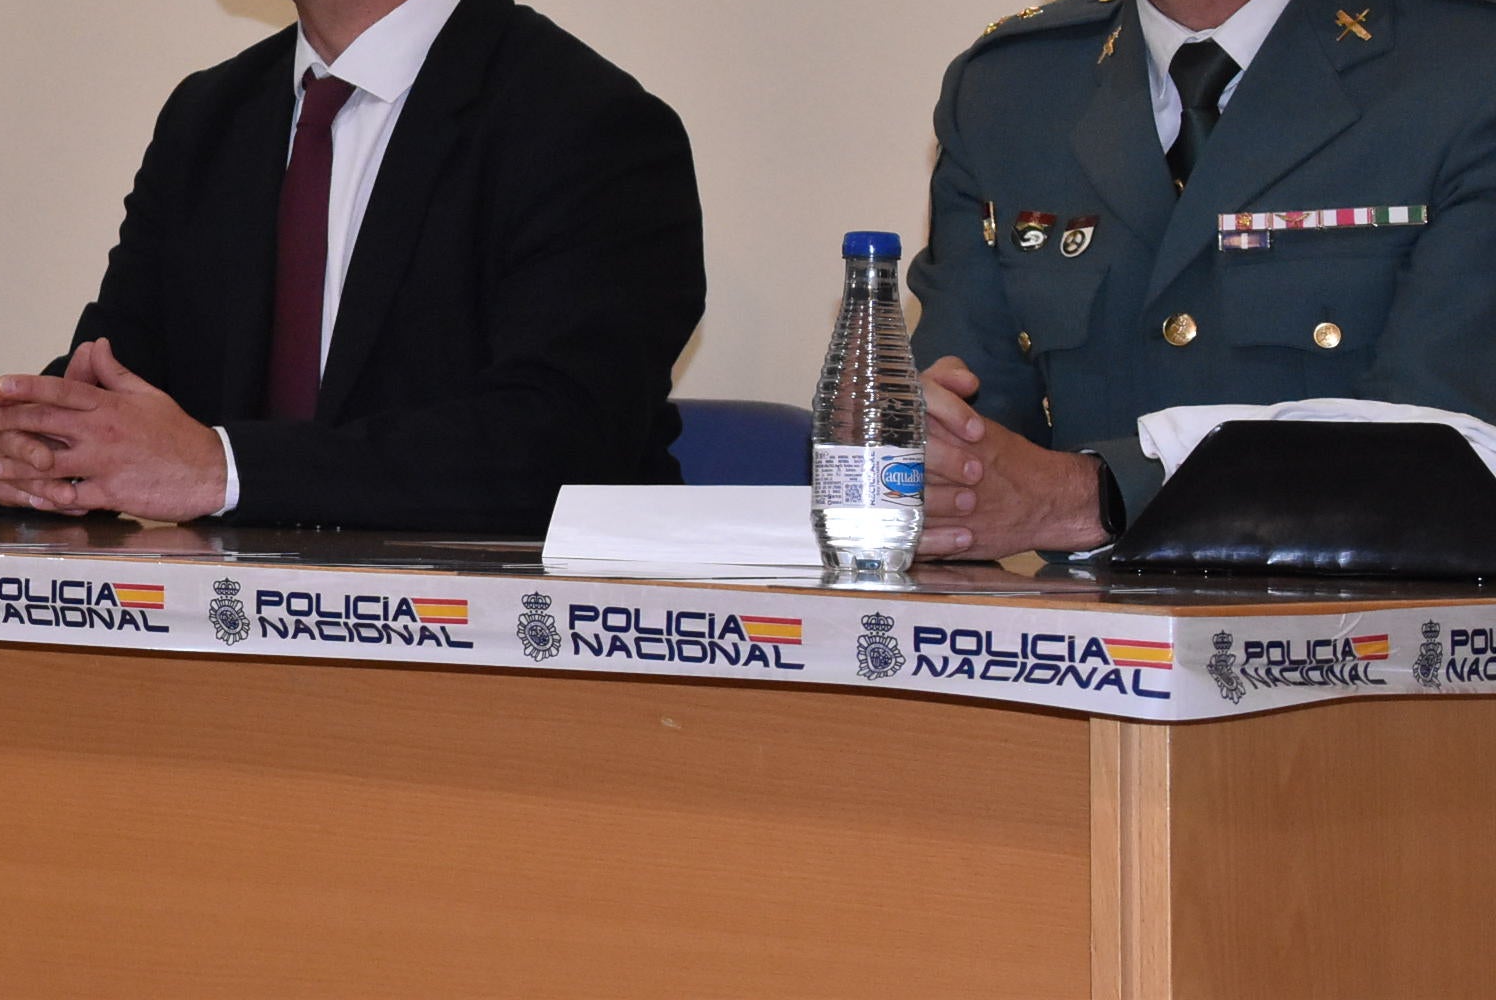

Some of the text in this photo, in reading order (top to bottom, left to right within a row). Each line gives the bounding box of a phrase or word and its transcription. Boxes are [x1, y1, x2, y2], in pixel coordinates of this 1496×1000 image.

[258, 616, 474, 649] NACIONAL
[571, 632, 805, 670] NACIONAL
[912, 654, 1171, 699] NACIONAL
[1240, 662, 1388, 689] NACIONAL
